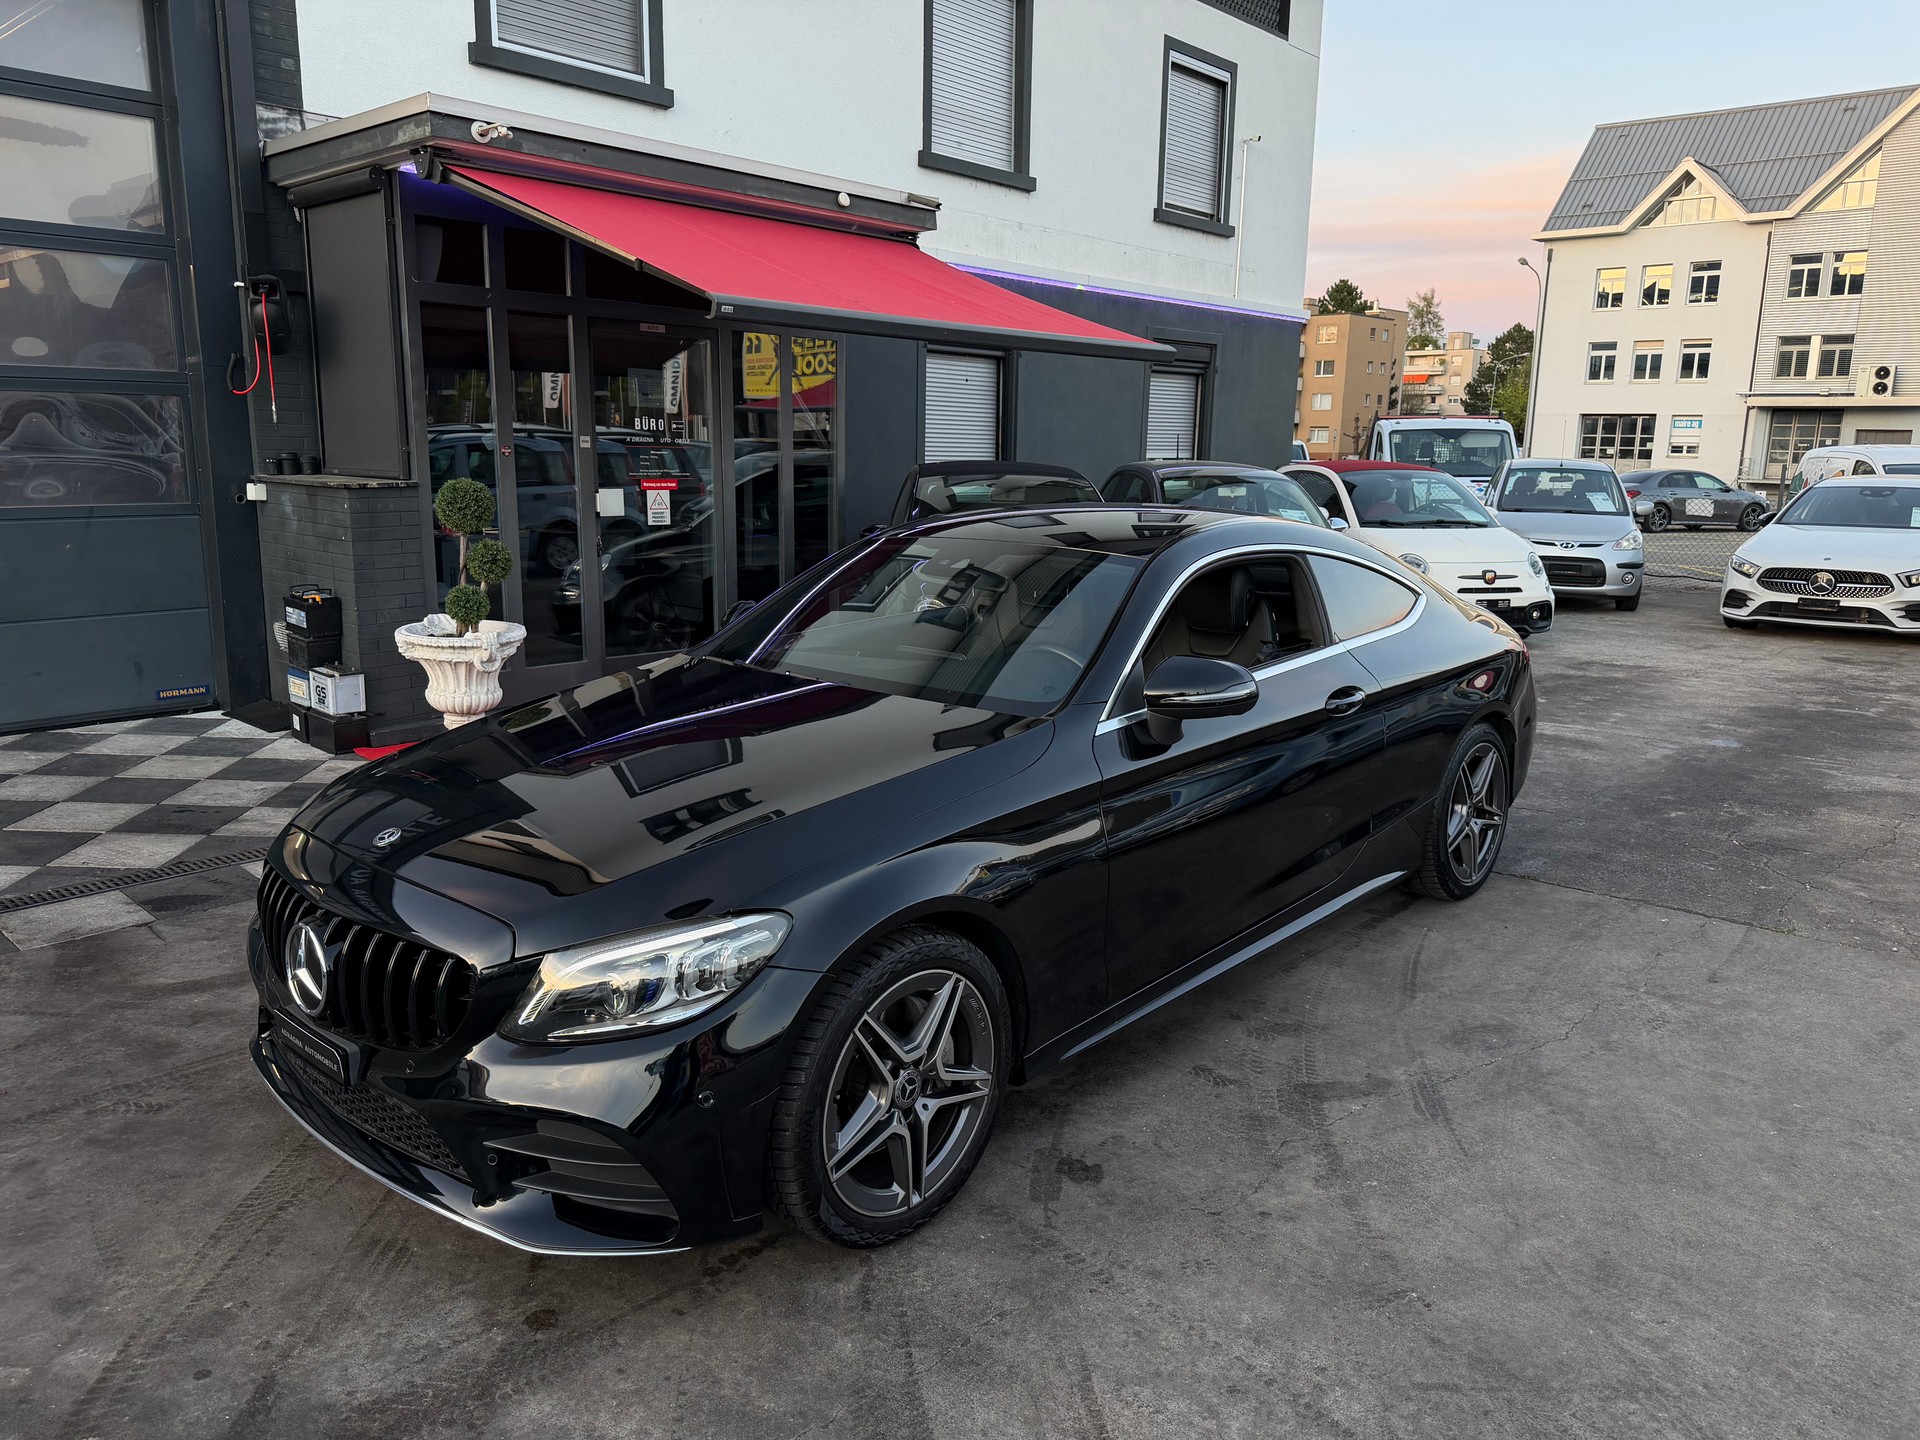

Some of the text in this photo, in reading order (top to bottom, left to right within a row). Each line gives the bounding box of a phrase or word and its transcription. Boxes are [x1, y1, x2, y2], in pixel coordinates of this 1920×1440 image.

[634, 416, 664, 431] BÜRO
[315, 685, 327, 699] GS
[304, 1045, 338, 1073] AUTOMOBILE
